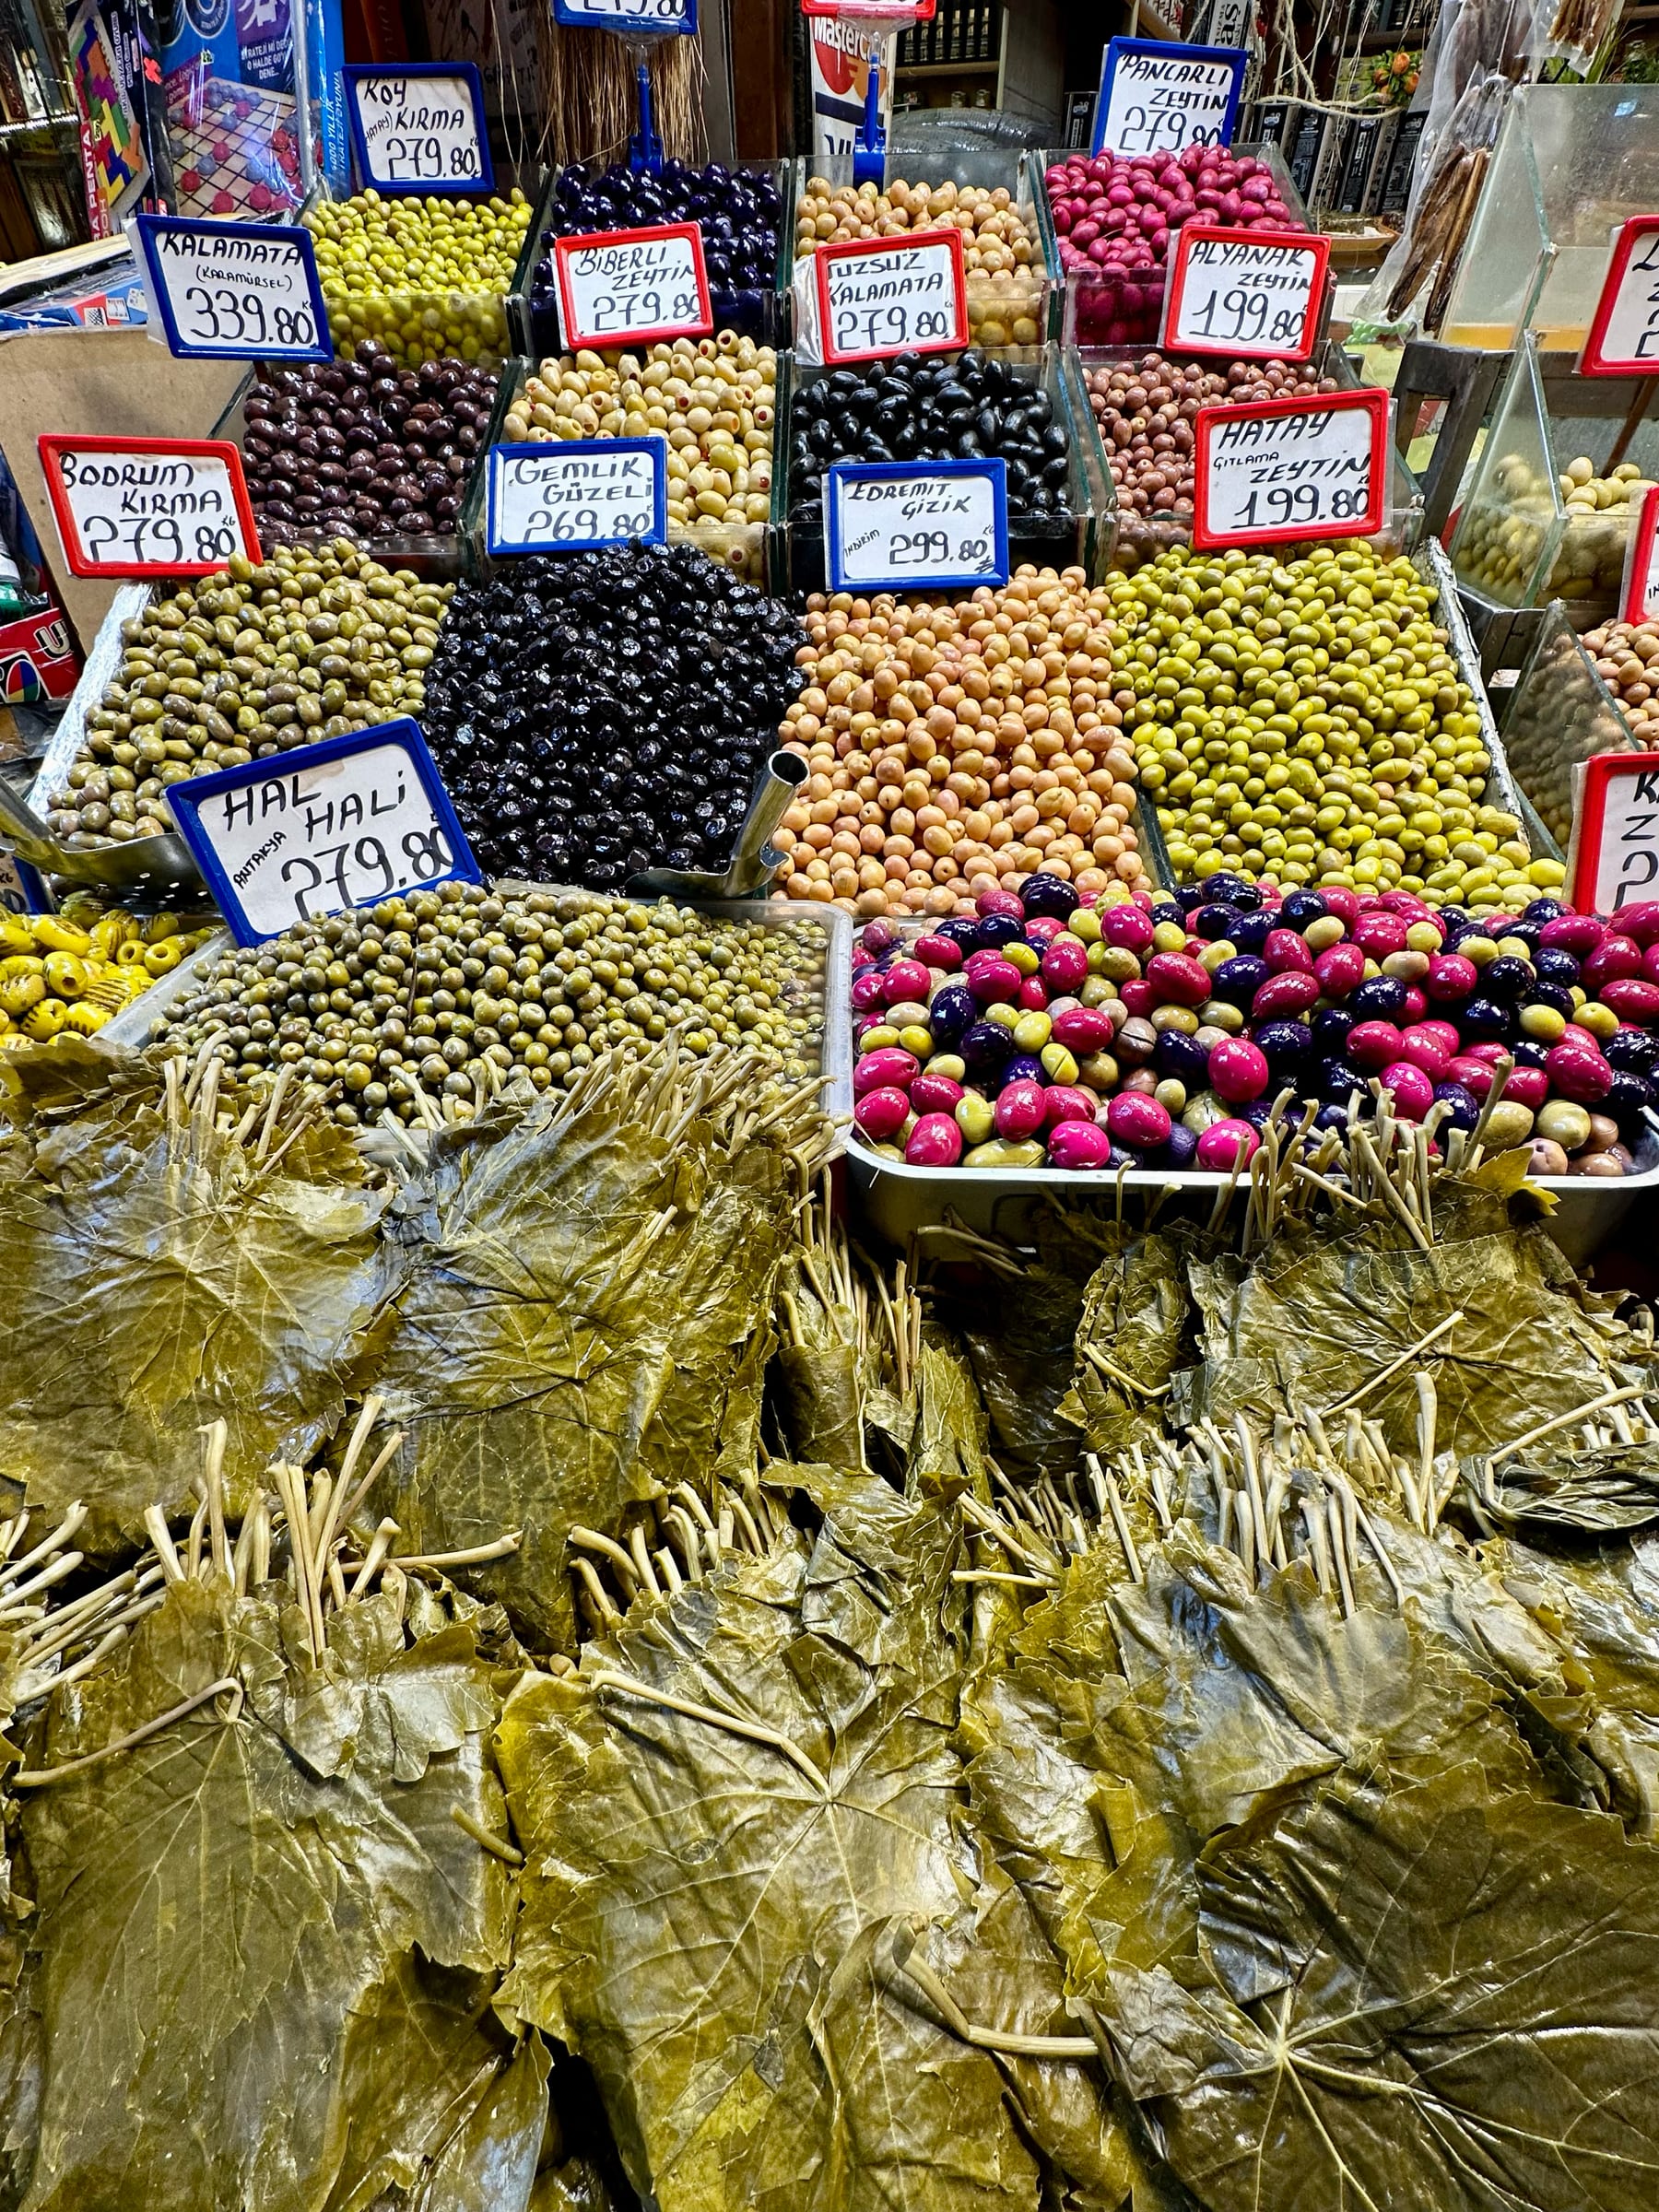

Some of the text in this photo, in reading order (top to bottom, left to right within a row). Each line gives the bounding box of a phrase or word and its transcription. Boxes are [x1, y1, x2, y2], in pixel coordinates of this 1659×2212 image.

[394, 106, 465, 131] KIRMA
[82, 129, 99, 209] PENTA
[385, 136, 477, 181] 279.80
[162, 232, 303, 266] KALAMATA
[1188, 240, 1305, 267] ALYANAK
[195, 264, 293, 293] (KARAMÜRSEL)
[830, 272, 944, 307] KALAMATA
[185, 287, 314, 345] 339.80
[837, 305, 947, 351] 279.80
[1188, 288, 1307, 342] 199.80
[1218, 408, 1335, 451] HATAY
[59, 452, 195, 489] BODRUM
[1249, 448, 1372, 484] ZEYTİN
[121, 489, 223, 517] KIRMA
[1230, 484, 1371, 530] 199.80
[83, 515, 237, 563] 279.80
[523, 509, 652, 544] 269.80
[888, 530, 988, 566] 299.80
[221, 774, 323, 832] HAL
[232, 831, 288, 890] ANTAKYA
[280, 826, 455, 924] 279.80
